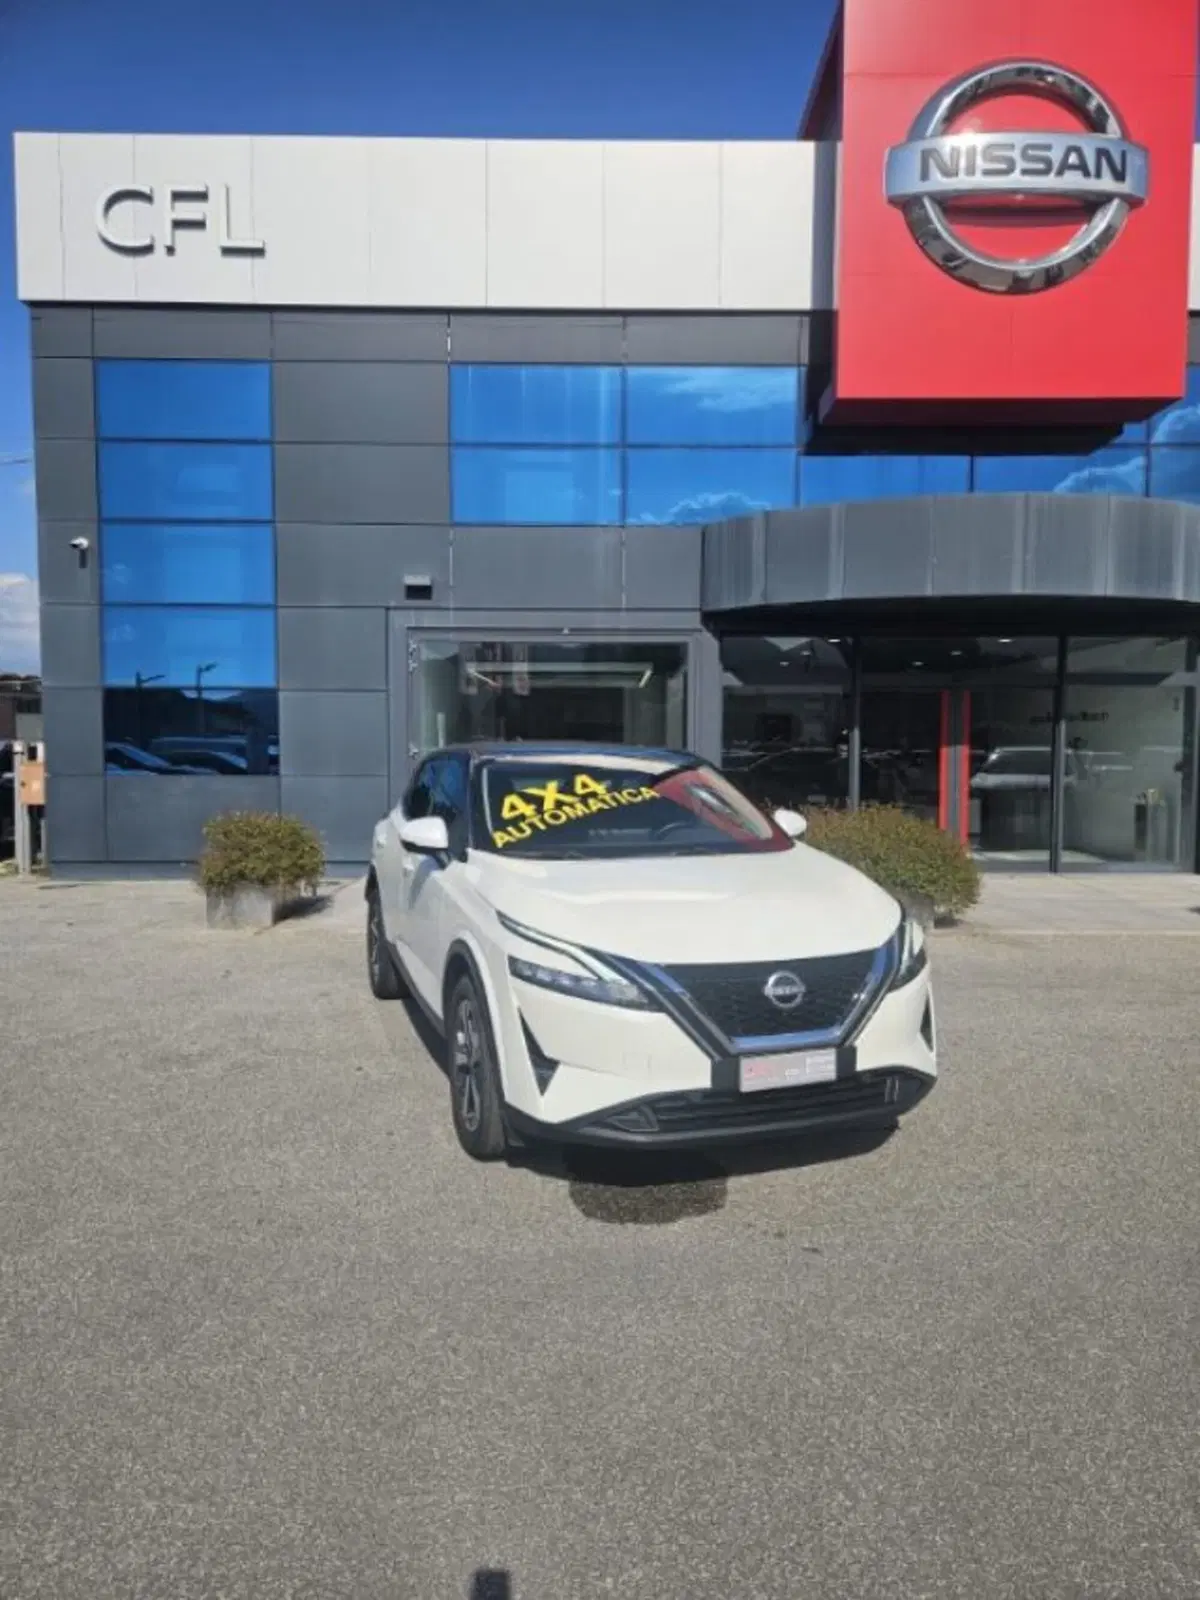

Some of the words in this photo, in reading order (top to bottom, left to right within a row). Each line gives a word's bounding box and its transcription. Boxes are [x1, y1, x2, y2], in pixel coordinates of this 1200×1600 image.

[919, 142, 1128, 182] NISSAN
[96, 184, 266, 257] CFL
[491, 787, 661, 849] AUTOMATICA
[500, 772, 609, 821] 4X4
